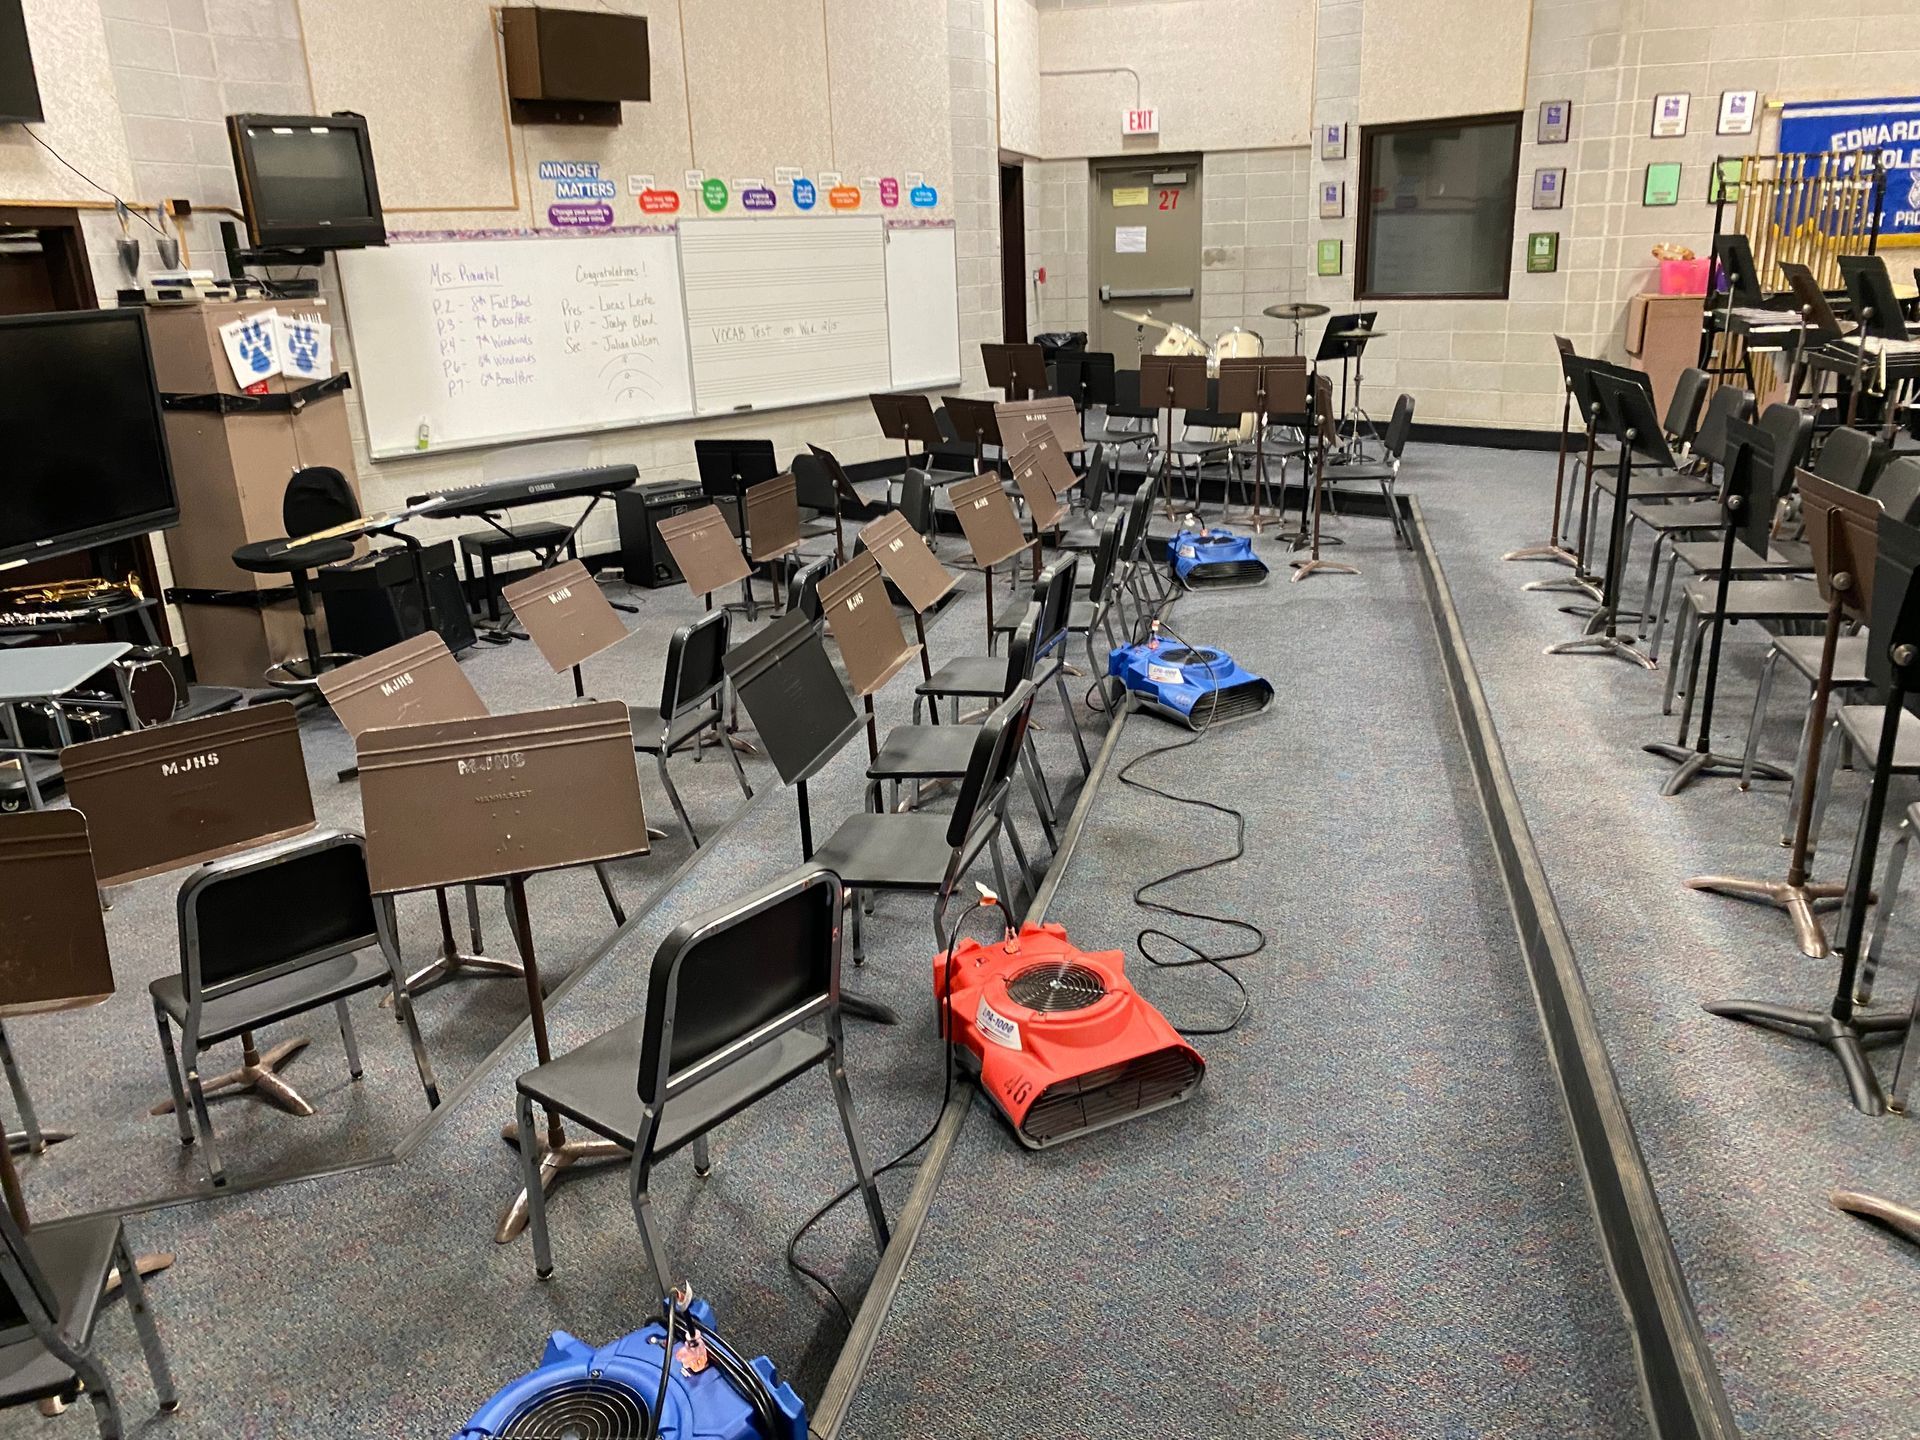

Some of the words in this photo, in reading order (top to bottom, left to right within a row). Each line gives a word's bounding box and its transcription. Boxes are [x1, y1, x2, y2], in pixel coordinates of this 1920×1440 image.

[1129, 110, 1154, 131] EXIT
[540, 163, 599, 179] MINDSET
[557, 182, 615, 198] MATTERS
[1158, 189, 1180, 211] 27
[711, 324, 747, 344] VOCAB
[750, 323, 773, 339] Test
[846, 592, 864, 612] MJHS
[380, 672, 414, 697] MJHS
[161, 752, 220, 777] MJHS
[457, 752, 526, 775] MJHS
